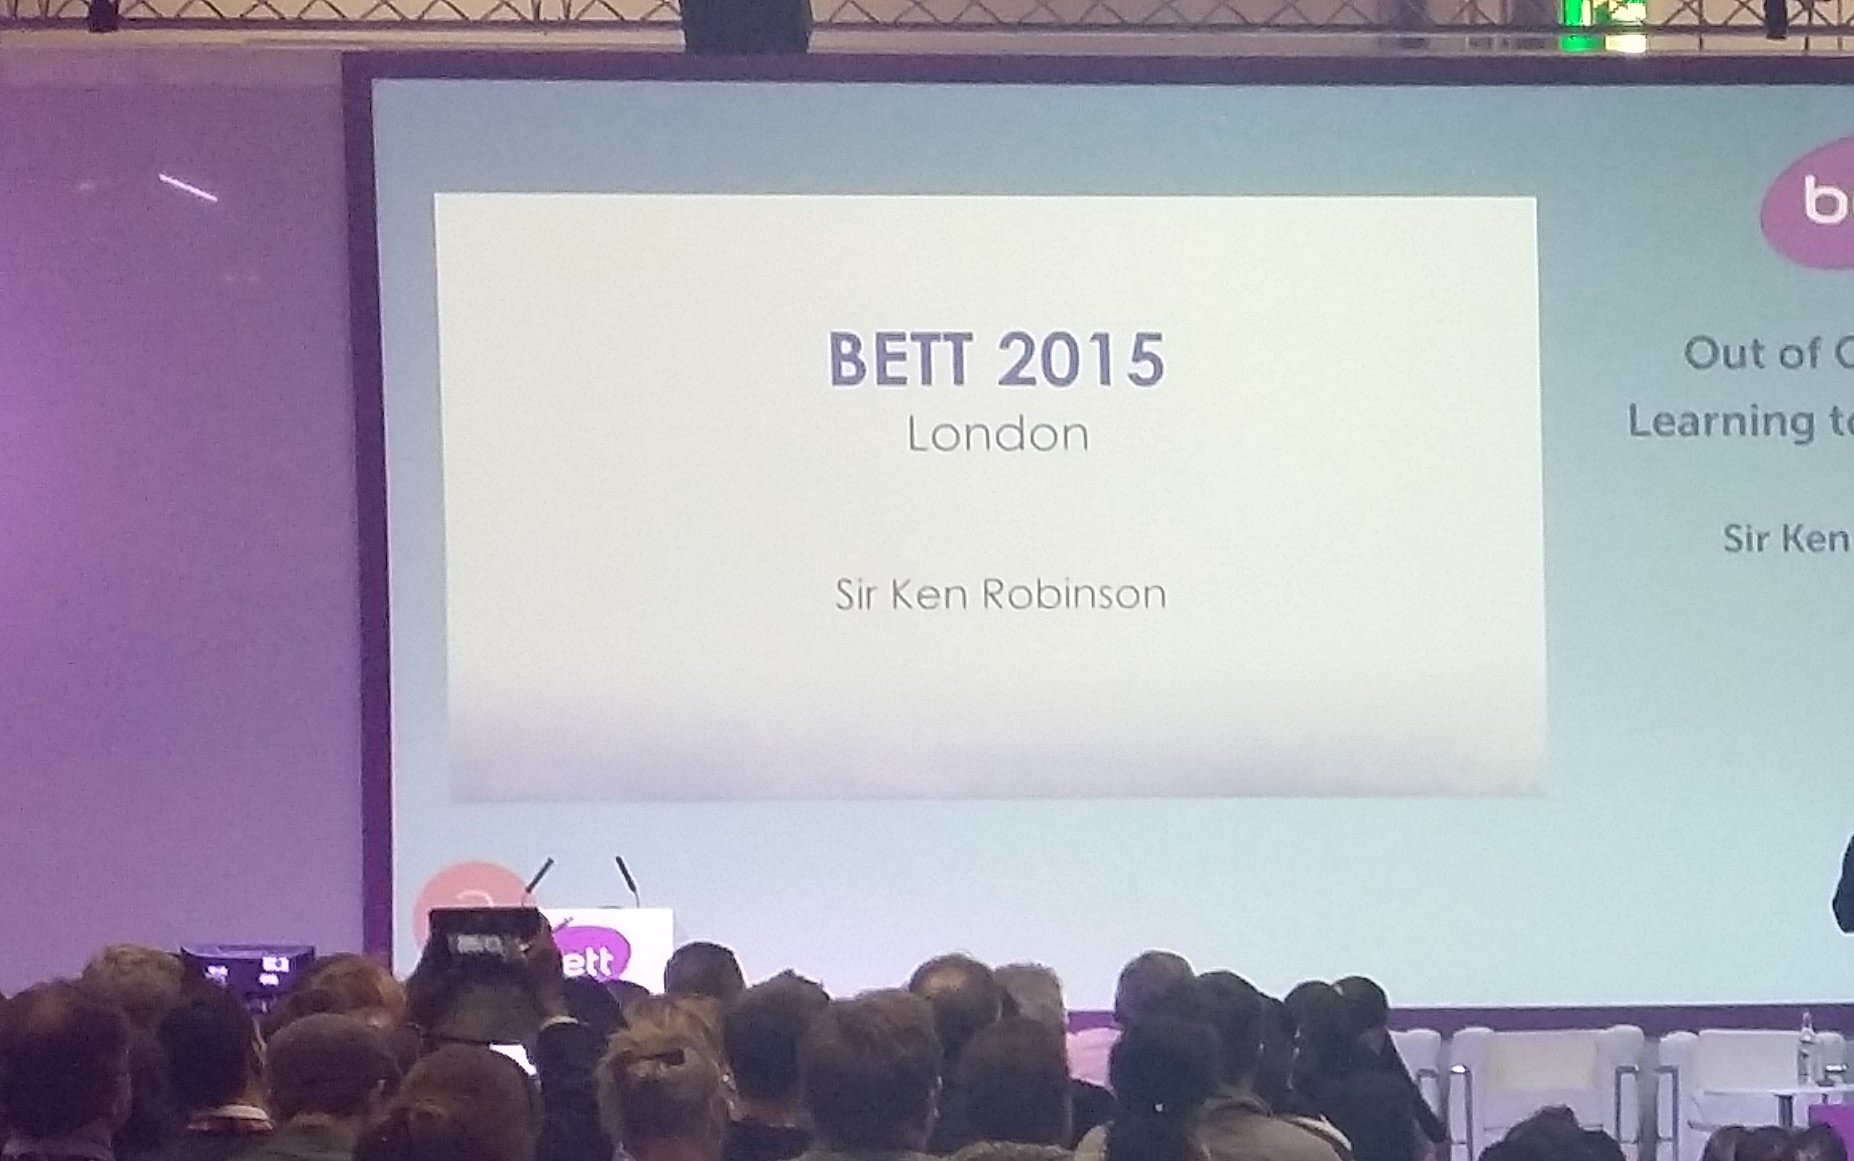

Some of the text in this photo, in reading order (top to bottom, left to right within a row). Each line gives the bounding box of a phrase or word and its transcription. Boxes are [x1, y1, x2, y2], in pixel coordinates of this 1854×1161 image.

[828, 330, 1166, 389] BETT 2015
[1683, 333, 1766, 371] Out
[1777, 334, 1823, 371] of
[907, 412, 1090, 454] London
[1628, 401, 1816, 446] Learning
[1722, 522, 1770, 554] Sir
[1781, 522, 1850, 554] Ken
[834, 576, 1168, 612] Sir Ken Robinson
[561, 945, 615, 978] ett
